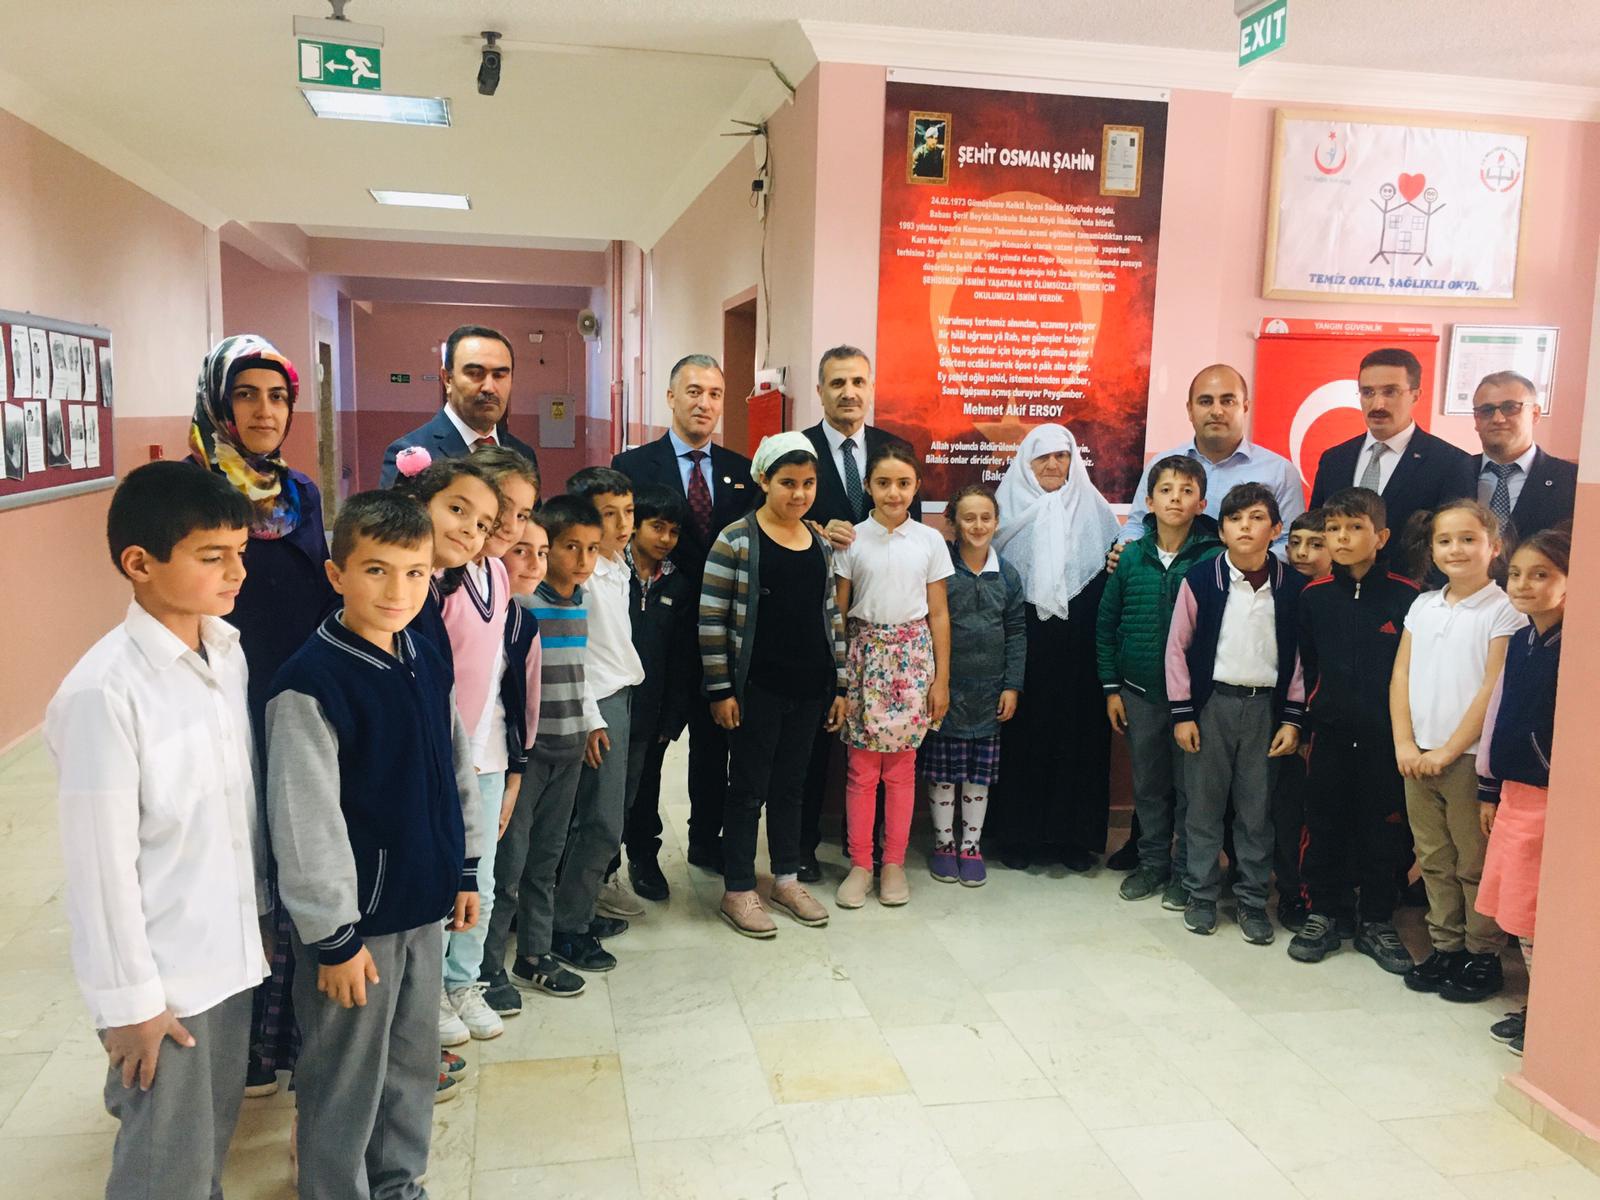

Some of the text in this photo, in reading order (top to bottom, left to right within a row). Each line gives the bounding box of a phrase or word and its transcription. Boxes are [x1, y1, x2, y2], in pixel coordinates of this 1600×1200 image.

[1240, 7, 1286, 57] EXIT
[958, 142, 996, 168] ŞEHİT
[999, 148, 1050, 168] OSMAN
[1053, 148, 1095, 174] ŞAHİN
[1044, 203, 1064, 212] Sadak
[899, 221, 914, 230] 1993
[1124, 234, 1143, 243] sonra,
[927, 250, 934, 258] 23
[1101, 246, 1130, 255] yaparken
[987, 279, 1022, 288] YAŞATMAK
[1309, 272, 1345, 285] TEMİZ
[1388, 276, 1445, 289] SAĞLIKLI
[974, 291, 1015, 300] OKULUMUZA
[1314, 322, 1383, 332] YANGIN GÜVENLİK
[952, 344, 960, 353] bu
[962, 345, 996, 356] topraklar
[997, 345, 1010, 357] için
[1012, 346, 1040, 358] toprağa
[990, 359, 1013, 368] inerek
[1015, 360, 1031, 372] öpse
[938, 372, 947, 383] Ey
[969, 373, 984, 384] oğlu
[986, 374, 1008, 384] şehid,
[1009, 374, 1033, 383] isteme
[1034, 375, 1060, 384] benden
[942, 386, 958, 395] Sana
[1013, 388, 1041, 400] duruyor
[963, 402, 1064, 416] Mehmet Akif ERSOY
[930, 441, 949, 450] Allah
[950, 442, 978, 453] yolunda
[925, 455, 949, 464] Bilakis
[950, 456, 968, 464] onlar
